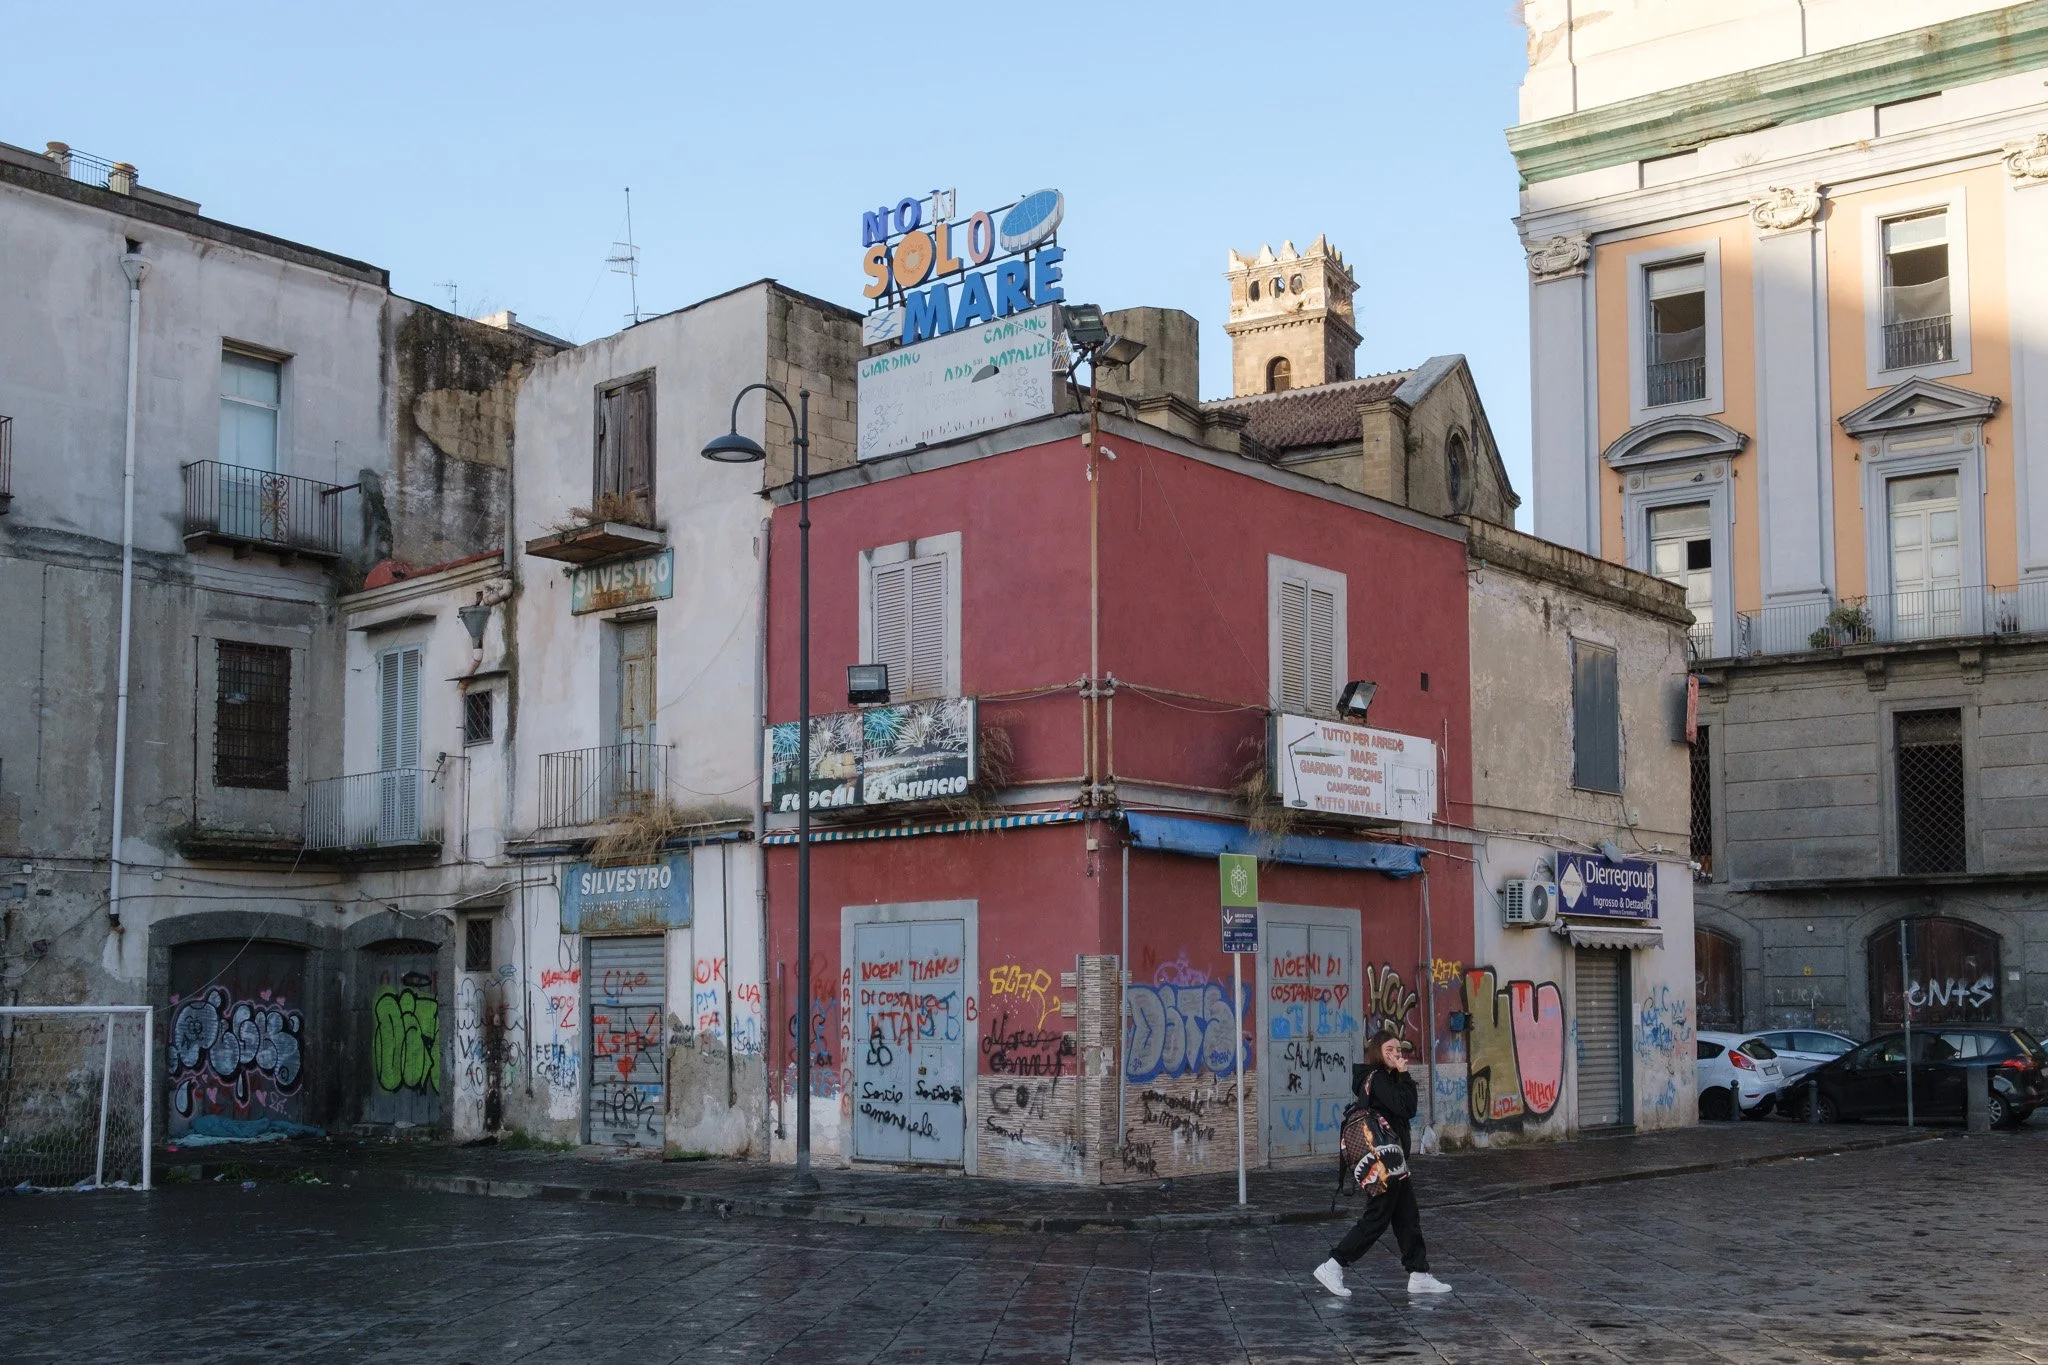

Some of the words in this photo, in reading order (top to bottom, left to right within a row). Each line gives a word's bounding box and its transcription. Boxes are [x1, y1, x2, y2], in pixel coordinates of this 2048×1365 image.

[862, 186, 956, 248] NON
[862, 210, 996, 300] SOLO
[902, 246, 1066, 346] MARE
[574, 555, 670, 599] SILVESTRO
[1321, 726, 1351, 744] TUTTO
[1352, 733, 1370, 749] PER
[1371, 735, 1405, 753] ARREDO
[1350, 748, 1378, 766] MARE
[1300, 759, 1343, 778] GIARDINO
[1347, 766, 1383, 784] PISCINE
[1326, 780, 1371, 797] CAMPEGGIO
[1314, 794, 1345, 811] TUTTO
[1347, 799, 1382, 814] NATALE
[581, 865, 672, 896] SILVESTRO
[1585, 860, 1655, 893] Dierregroup
[1592, 894, 1619, 910] Ingrosso
[1619, 897, 1625, 909] &
[1625, 898, 1652, 912] Dettaglio
[1274, 952, 1321, 979] NOEMI
[1326, 954, 1342, 976] DI
[1270, 982, 1333, 1004] COSTANZO
